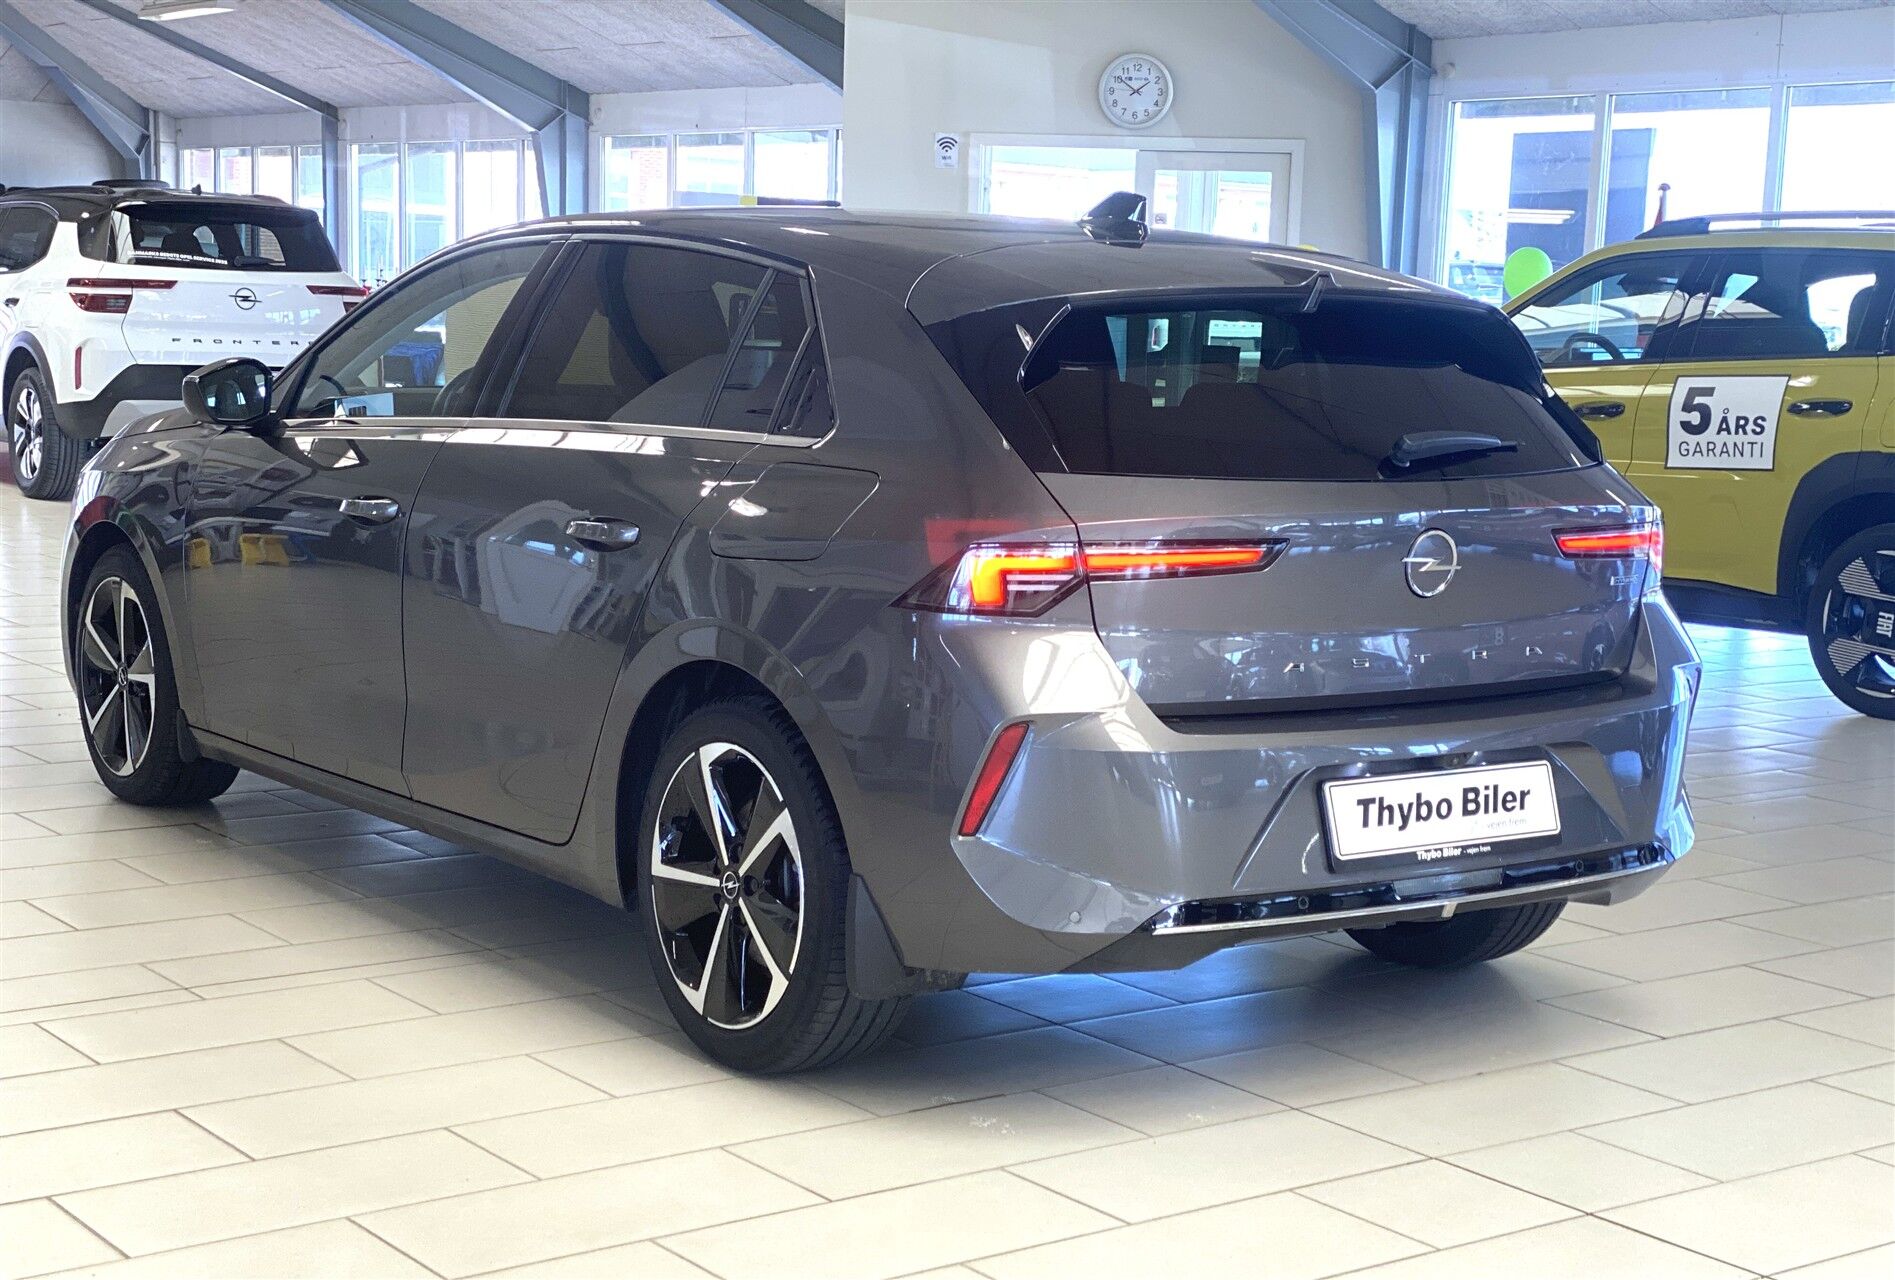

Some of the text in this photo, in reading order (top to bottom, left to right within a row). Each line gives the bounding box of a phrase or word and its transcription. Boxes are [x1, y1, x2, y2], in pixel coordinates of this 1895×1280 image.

[1122, 67, 1129, 75] 11
[1132, 63, 1142, 72] 12
[1113, 75, 1123, 84] 10
[1154, 75, 1160, 84] 2
[1108, 86, 1114, 95] 9
[1157, 87, 1163, 96] 3
[1112, 99, 1118, 107] 8
[1153, 99, 1159, 107] 4
[1121, 107, 1127, 115] 7
[1132, 111, 1138, 119] 6
[1144, 108, 1150, 117] 5
[1679, 386, 1768, 436] 5 ÅRS
[1678, 441, 1764, 458] GARANTI
[1875, 611, 1895, 638] FIAT
[1283, 645, 1543, 673] ASTRA
[1355, 784, 1532, 832] Thybo Biler
[1416, 849, 1442, 861] Thybo
[1442, 846, 1462, 858] Biler
